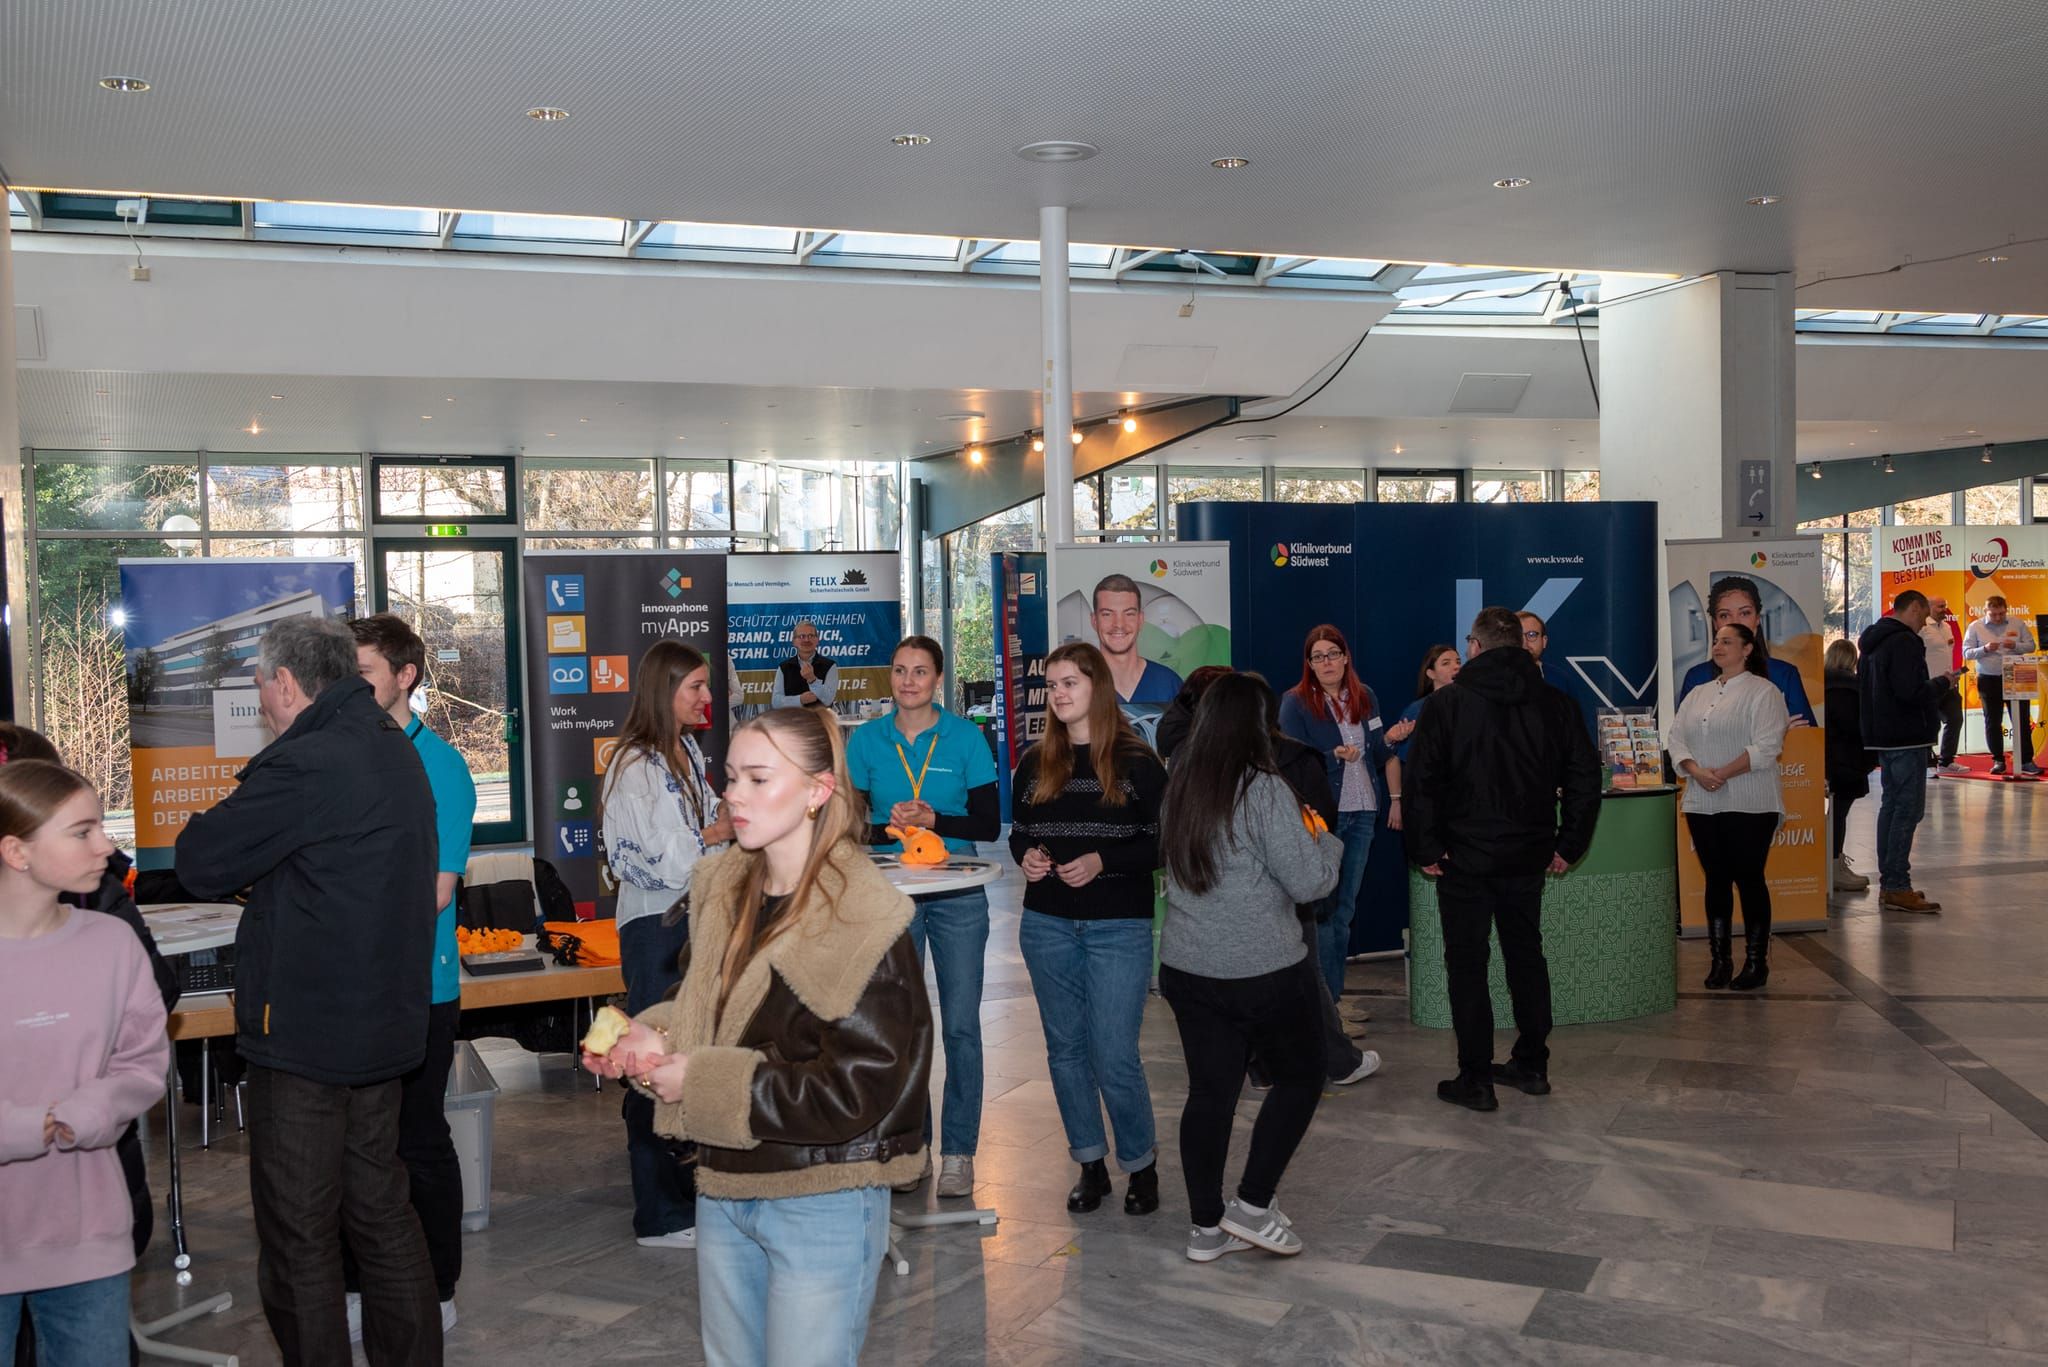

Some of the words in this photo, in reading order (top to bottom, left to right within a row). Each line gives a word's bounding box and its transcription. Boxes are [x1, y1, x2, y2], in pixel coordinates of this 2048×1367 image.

[1892, 534, 1924, 553] KOMM
[1926, 530, 1942, 546] INS
[1290, 543, 1352, 554] Klinikverbund
[1290, 555, 1329, 567] Südwest
[1527, 555, 1584, 564] www.kvsw.de
[1901, 548, 1931, 567] TEAM
[1933, 543, 1952, 560] DER
[1970, 552, 2000, 563] Kuder
[1173, 559, 1221, 568] Klinikverbund
[2002, 558, 2046, 568] CNC-Technik
[1173, 567, 1203, 576] Südwest
[1893, 563, 1935, 585] BESTEN!
[809, 577, 837, 586] FELIX
[641, 603, 709, 614] innovaphone
[727, 614, 780, 628] SCHÜTZT
[781, 613, 866, 627] UNTERNEHMEN
[641, 618, 709, 637] myApps
[727, 631, 774, 644] BRAND,
[773, 647, 798, 659] UND
[551, 706, 577, 716] Work
[551, 719, 574, 730] with
[575, 718, 615, 730] myApps
[154, 810, 190, 826] DER
